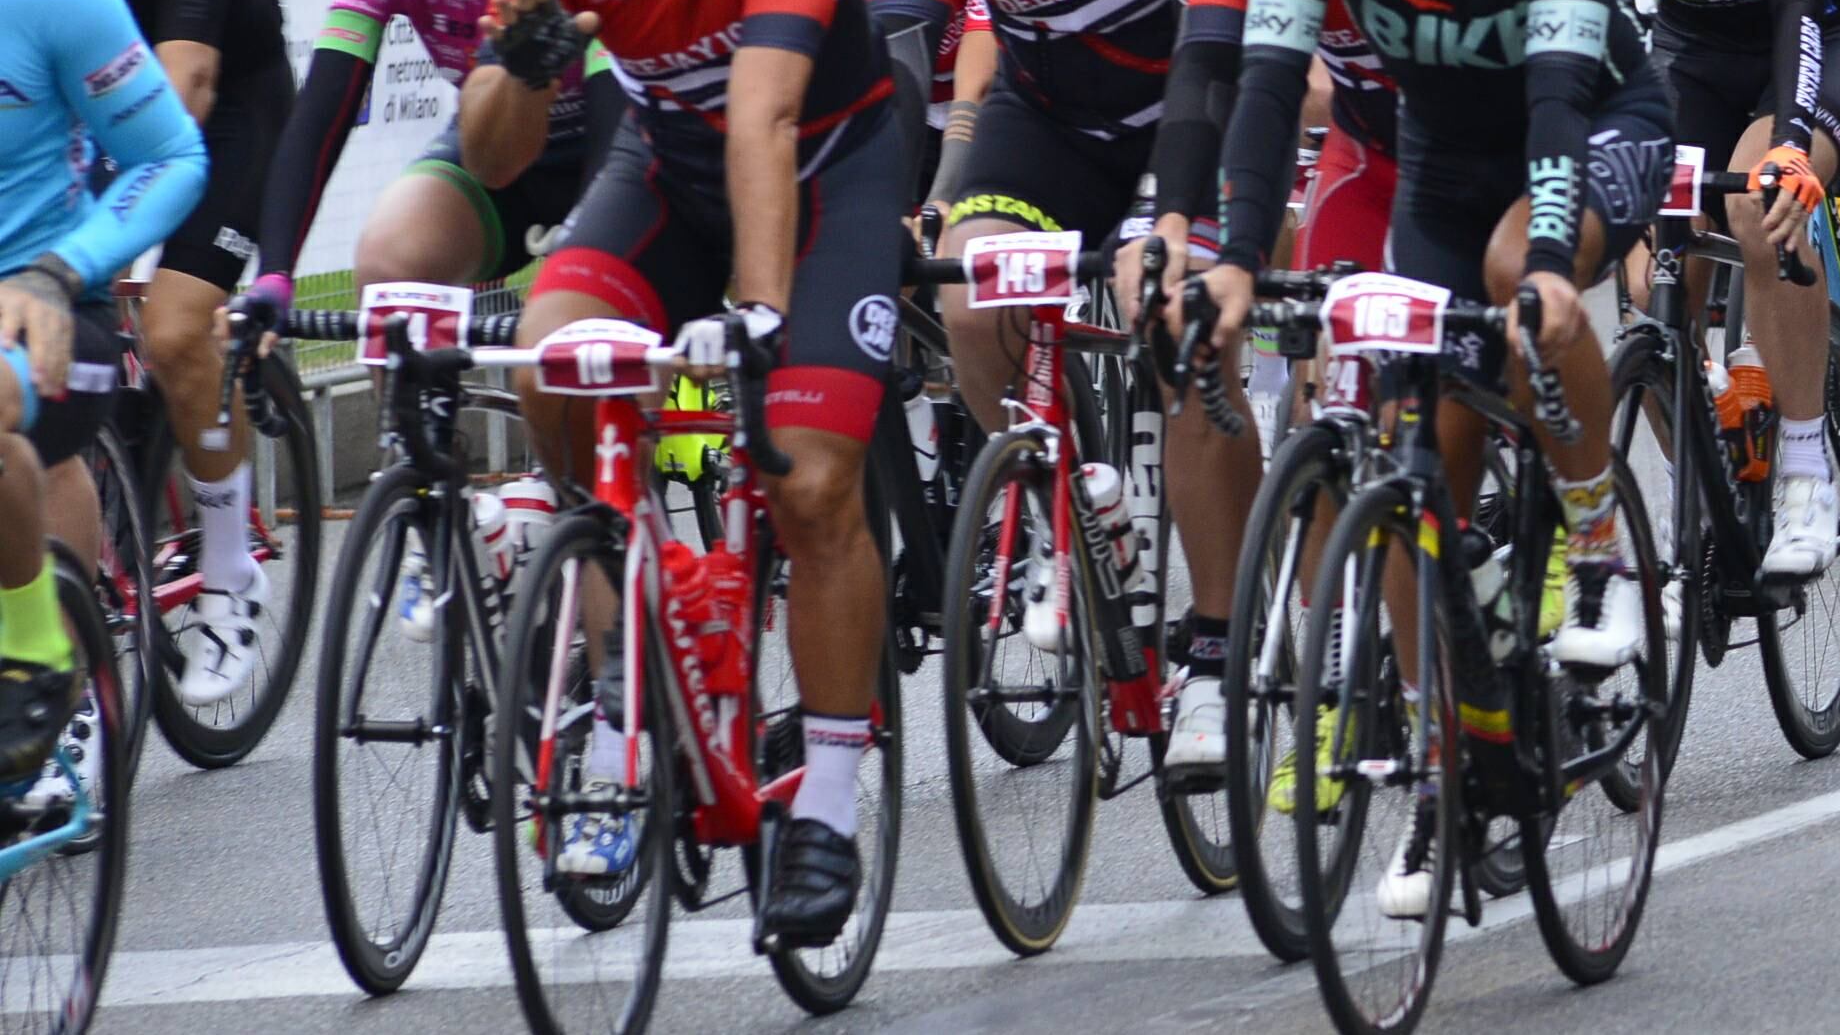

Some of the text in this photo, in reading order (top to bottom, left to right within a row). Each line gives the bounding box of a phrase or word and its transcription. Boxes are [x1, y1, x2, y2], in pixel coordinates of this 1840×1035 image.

[1794, 16, 1824, 114] SYSTEM CARS
[384, 92, 439, 123] di Milano
[1527, 154, 1572, 240] BIKE
[993, 252, 1047, 295] 143
